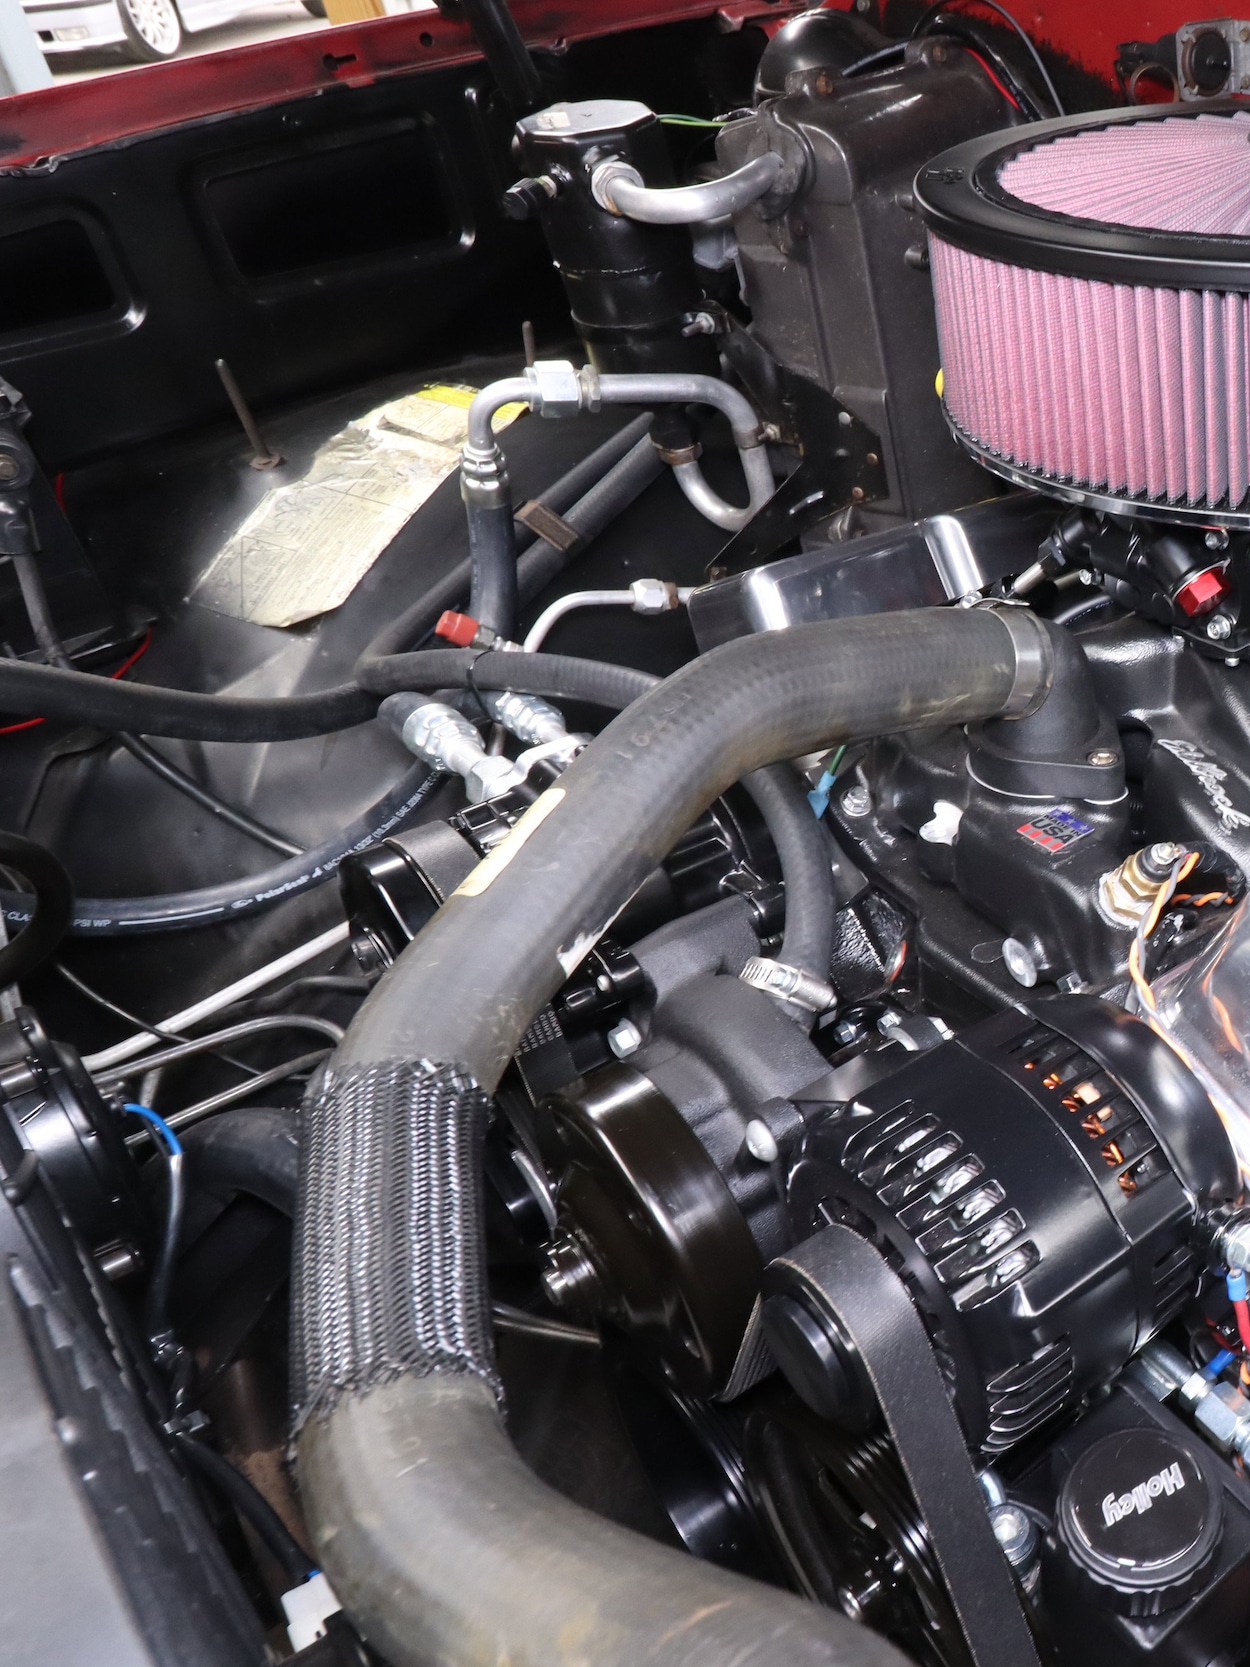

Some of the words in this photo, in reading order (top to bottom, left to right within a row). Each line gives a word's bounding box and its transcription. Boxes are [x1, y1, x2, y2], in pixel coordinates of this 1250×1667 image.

[419, 779, 434, 797] TYPE
[1043, 814, 1069, 830] MADE
[1031, 818, 1075, 845] USA
[73, 918, 91, 927] PSI
[92, 918, 112, 927] WP
[1101, 1461, 1186, 1527] Holley
